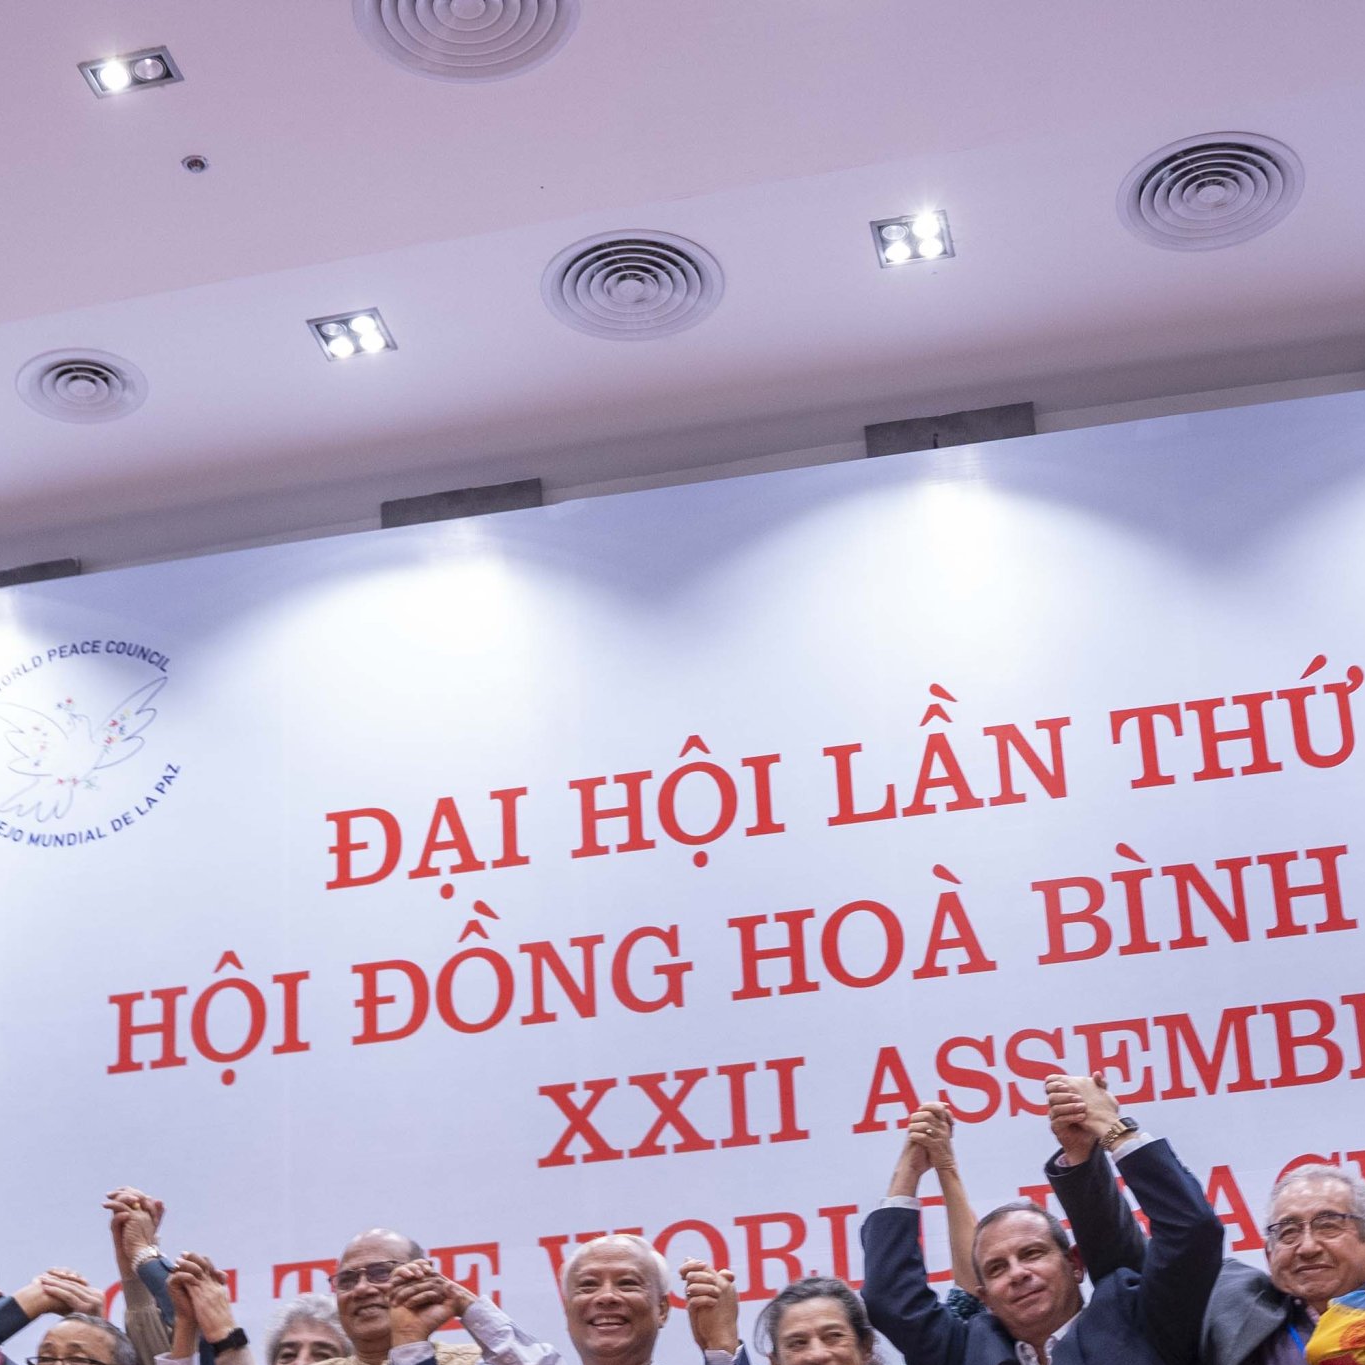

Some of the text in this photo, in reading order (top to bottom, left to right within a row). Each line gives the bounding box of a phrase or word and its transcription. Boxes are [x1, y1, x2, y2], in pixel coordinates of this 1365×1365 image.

[48, 640, 102, 662] PEACE
[105, 640, 170, 672] COUNCIL
[27, 827, 107, 847] MUNDIAL
[110, 812, 134, 832] DE
[136, 796, 158, 816] LA
[155, 763, 181, 794] PAZ
[326, 787, 530, 899] ĐẠI
[570, 735, 785, 867] HỘI
[823, 683, 1071, 826] LẦN
[1110, 655, 1364, 789] THỨ
[107, 951, 311, 1086] HỘI
[352, 900, 692, 1046] ĐỒNG
[729, 864, 996, 1001] HOÀ
[1032, 843, 1356, 965] BÌNH
[538, 1056, 808, 1168] XXII
